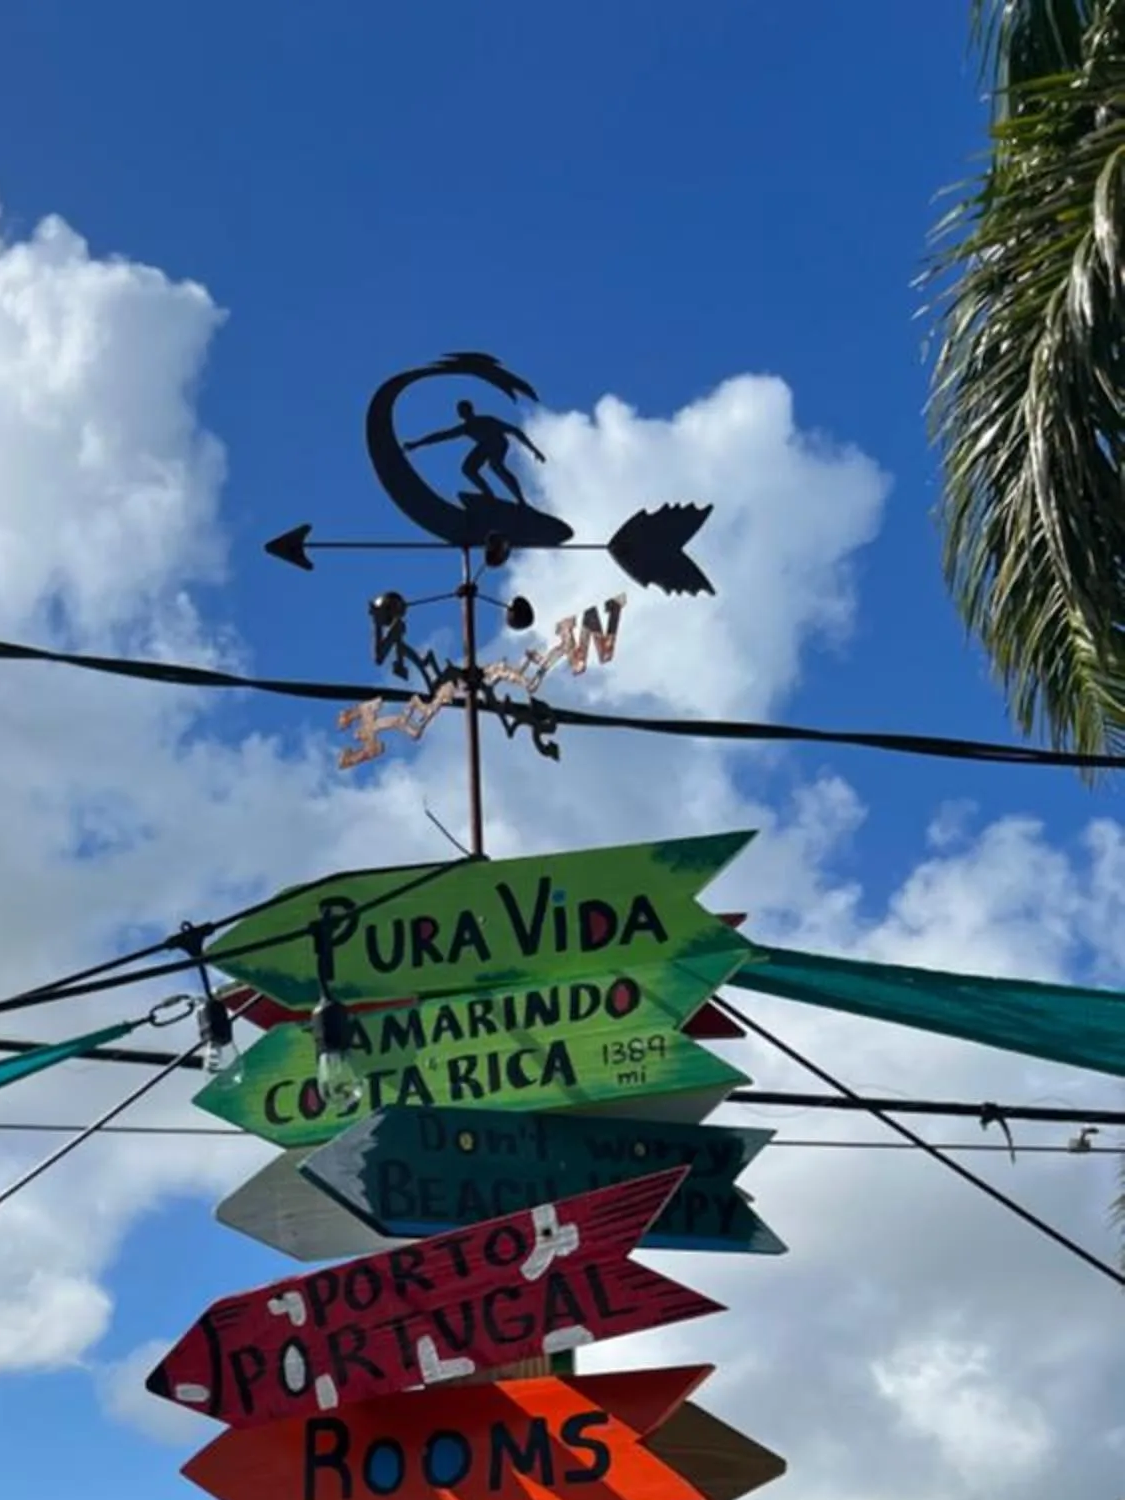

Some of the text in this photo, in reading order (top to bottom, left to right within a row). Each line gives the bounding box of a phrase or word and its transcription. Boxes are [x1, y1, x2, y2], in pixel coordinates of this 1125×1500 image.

[318, 896, 492, 981] PURA
[446, 1039, 578, 1103] RICA
[602, 1035, 668, 1068] 1389
[306, 1225, 527, 1327] PORTO
